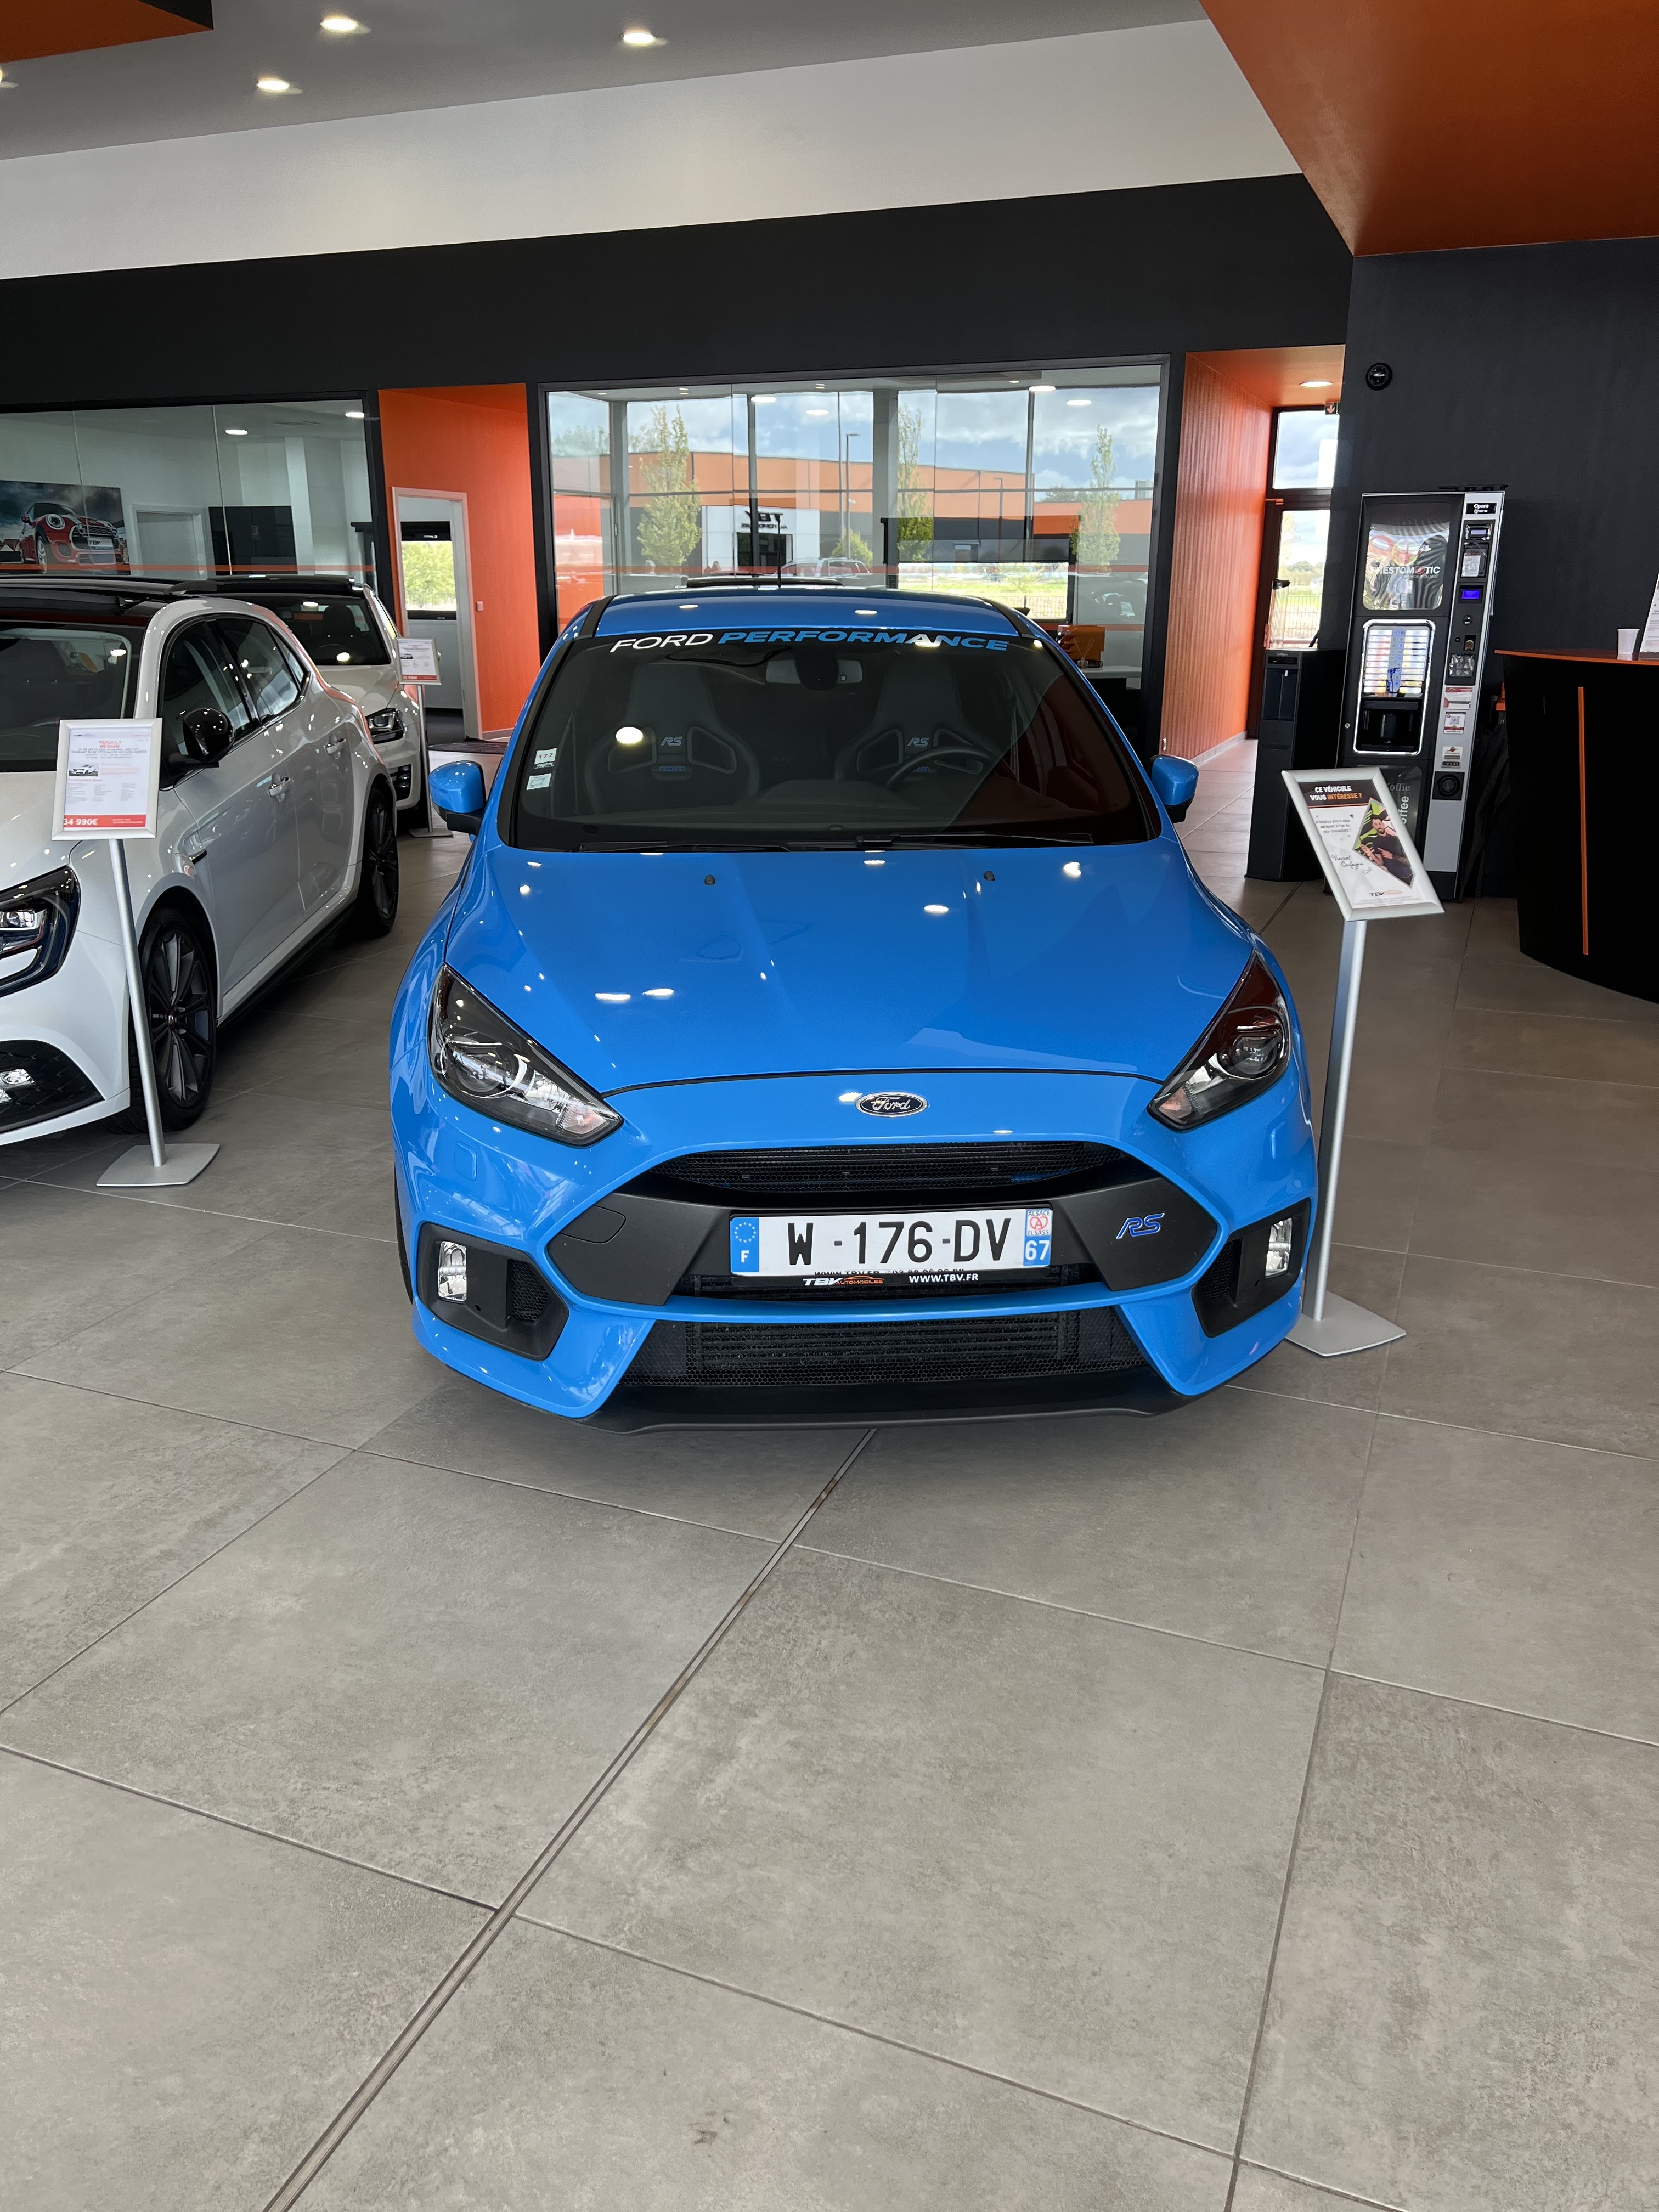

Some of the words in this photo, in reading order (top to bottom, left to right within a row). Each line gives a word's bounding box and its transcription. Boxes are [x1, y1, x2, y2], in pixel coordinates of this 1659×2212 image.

[610, 633, 713, 653] FORD
[718, 630, 1009, 651] PERFORMANCE
[661, 736, 683, 746] RS
[907, 737, 930, 747] RS
[1323, 785, 1352, 793] VÉHICULE
[1387, 782, 1410, 791] offie
[871, 1096, 910, 1110] Ford
[1115, 1211, 1165, 1239] RS
[1025, 1239, 1050, 1261] 67
[741, 1250, 750, 1263] F
[802, 1277, 843, 1286] TBV
[909, 1273, 979, 1283] WWW.TBV.FR
